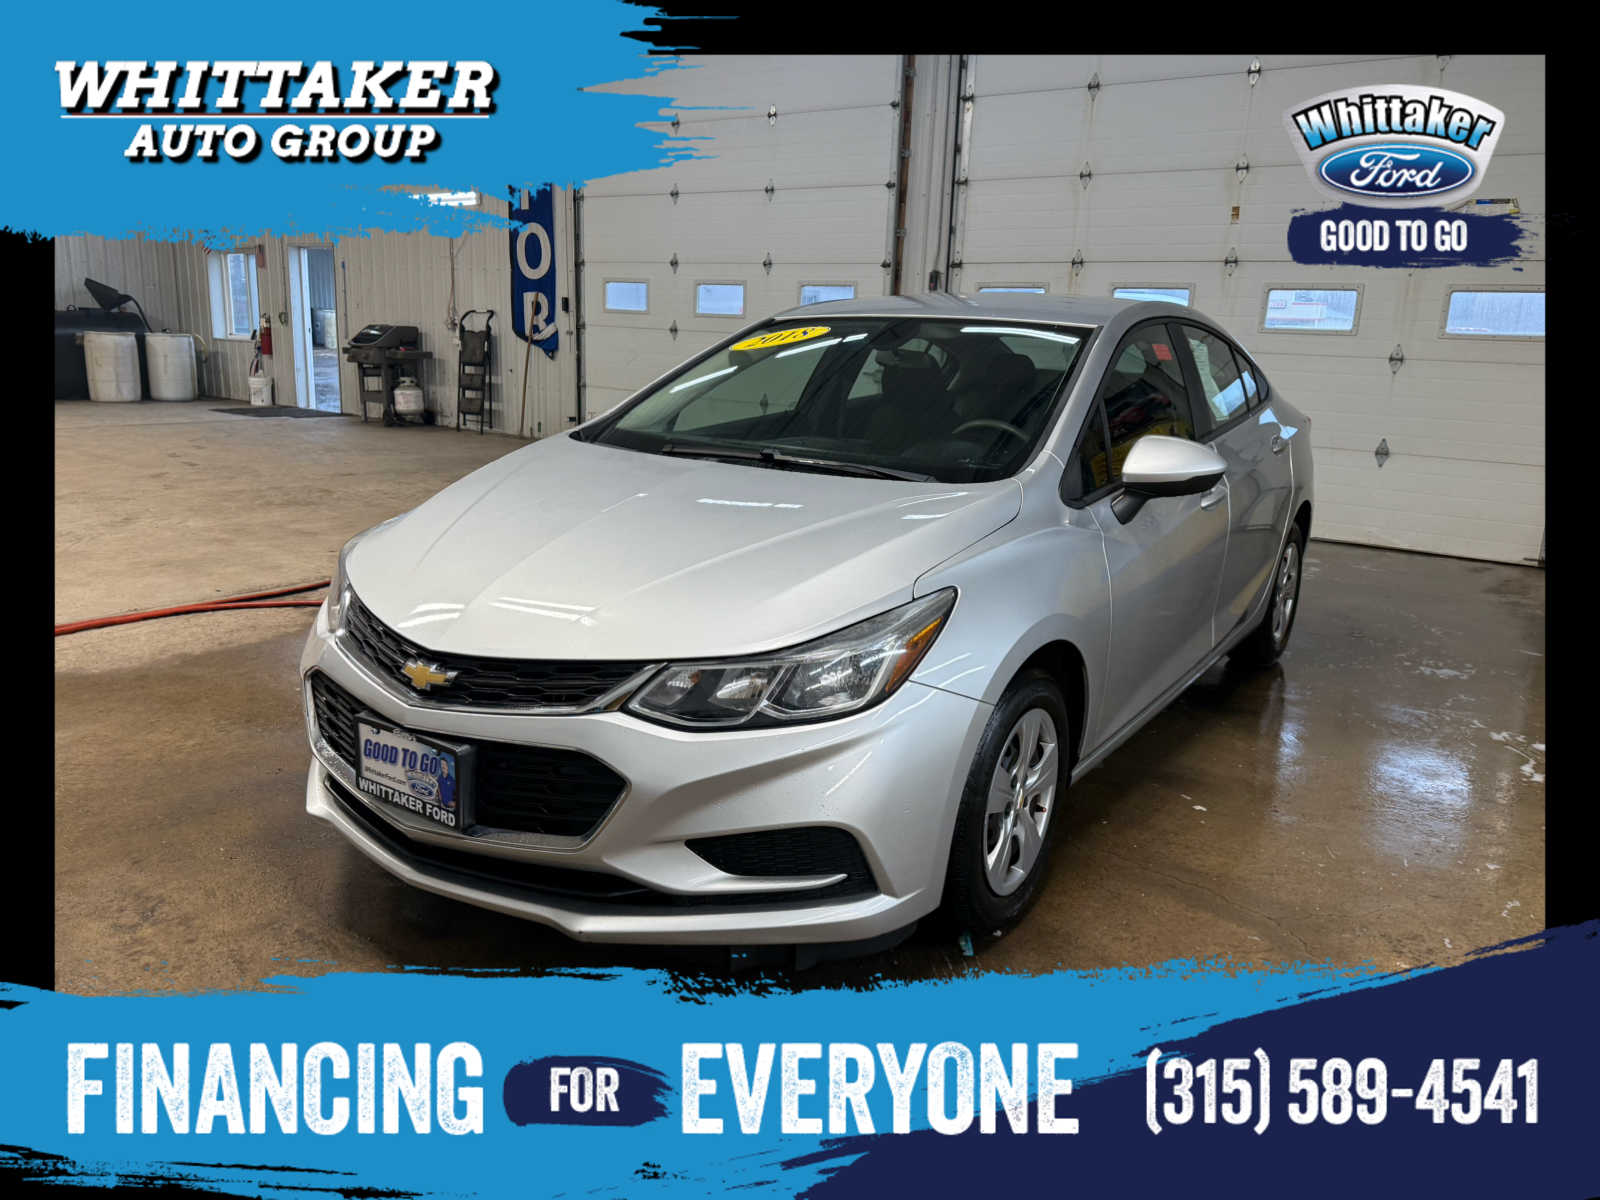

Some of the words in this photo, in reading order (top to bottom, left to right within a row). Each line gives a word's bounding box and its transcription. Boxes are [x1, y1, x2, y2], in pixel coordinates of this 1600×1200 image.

[743, 327, 817, 349] 2018
[364, 738, 399, 764] GOOD
[402, 748, 418, 769] TO
[420, 753, 438, 775] GO
[359, 777, 424, 814] WHITTAKER
[425, 804, 456, 827] FORD
